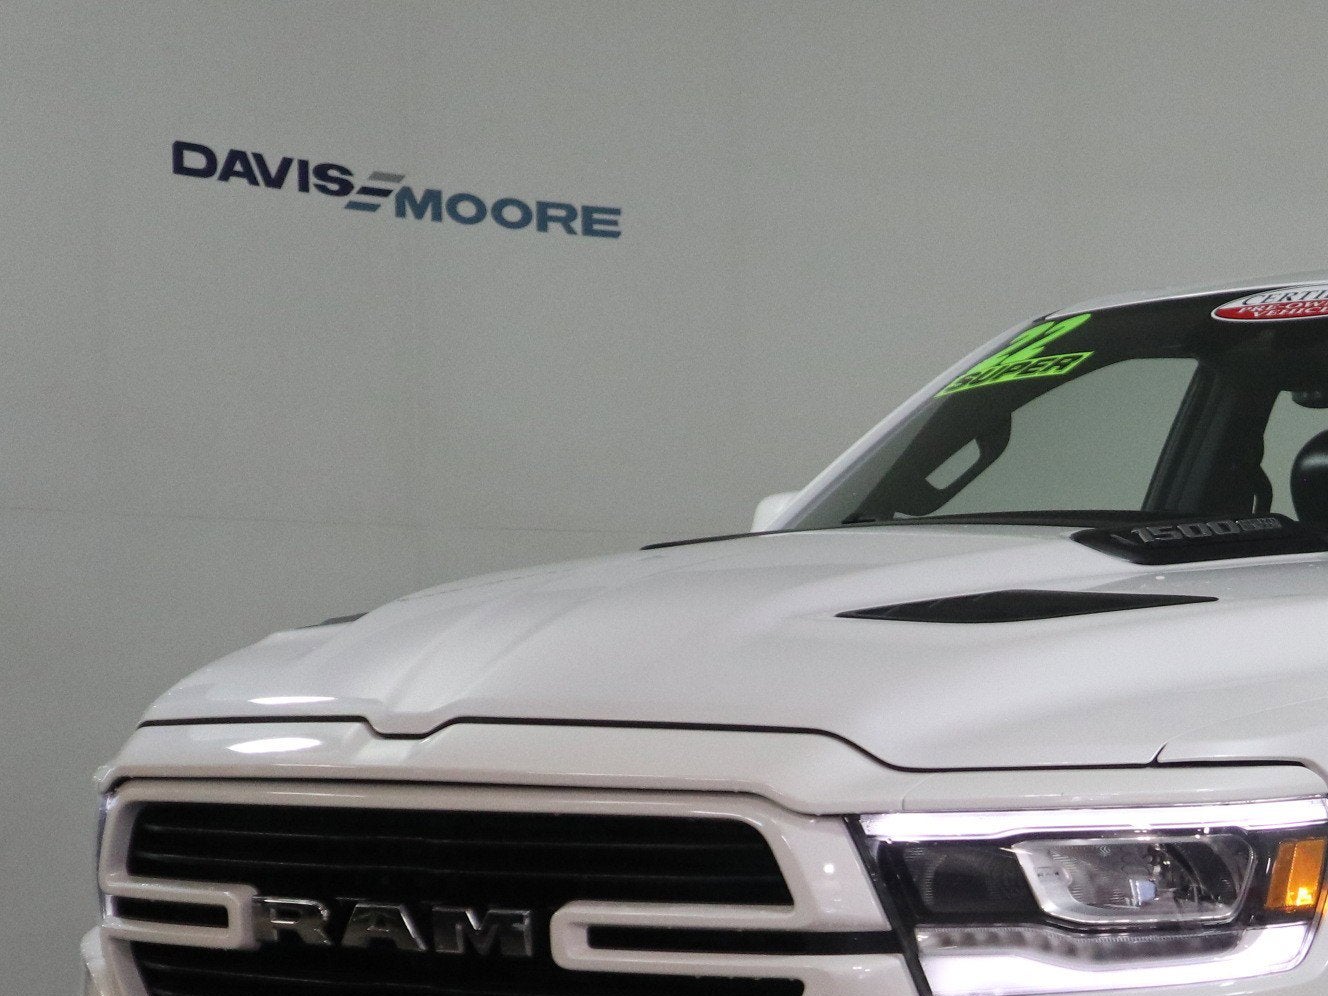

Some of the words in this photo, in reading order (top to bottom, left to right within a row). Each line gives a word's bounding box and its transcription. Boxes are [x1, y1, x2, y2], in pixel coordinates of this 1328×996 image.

[172, 140, 355, 197] DAVIS
[394, 186, 622, 239] MOORE
[947, 354, 1084, 389] SUPER
[966, 313, 1092, 374] 22
[1131, 519, 1240, 544] 1500
[252, 896, 532, 957] RAM
